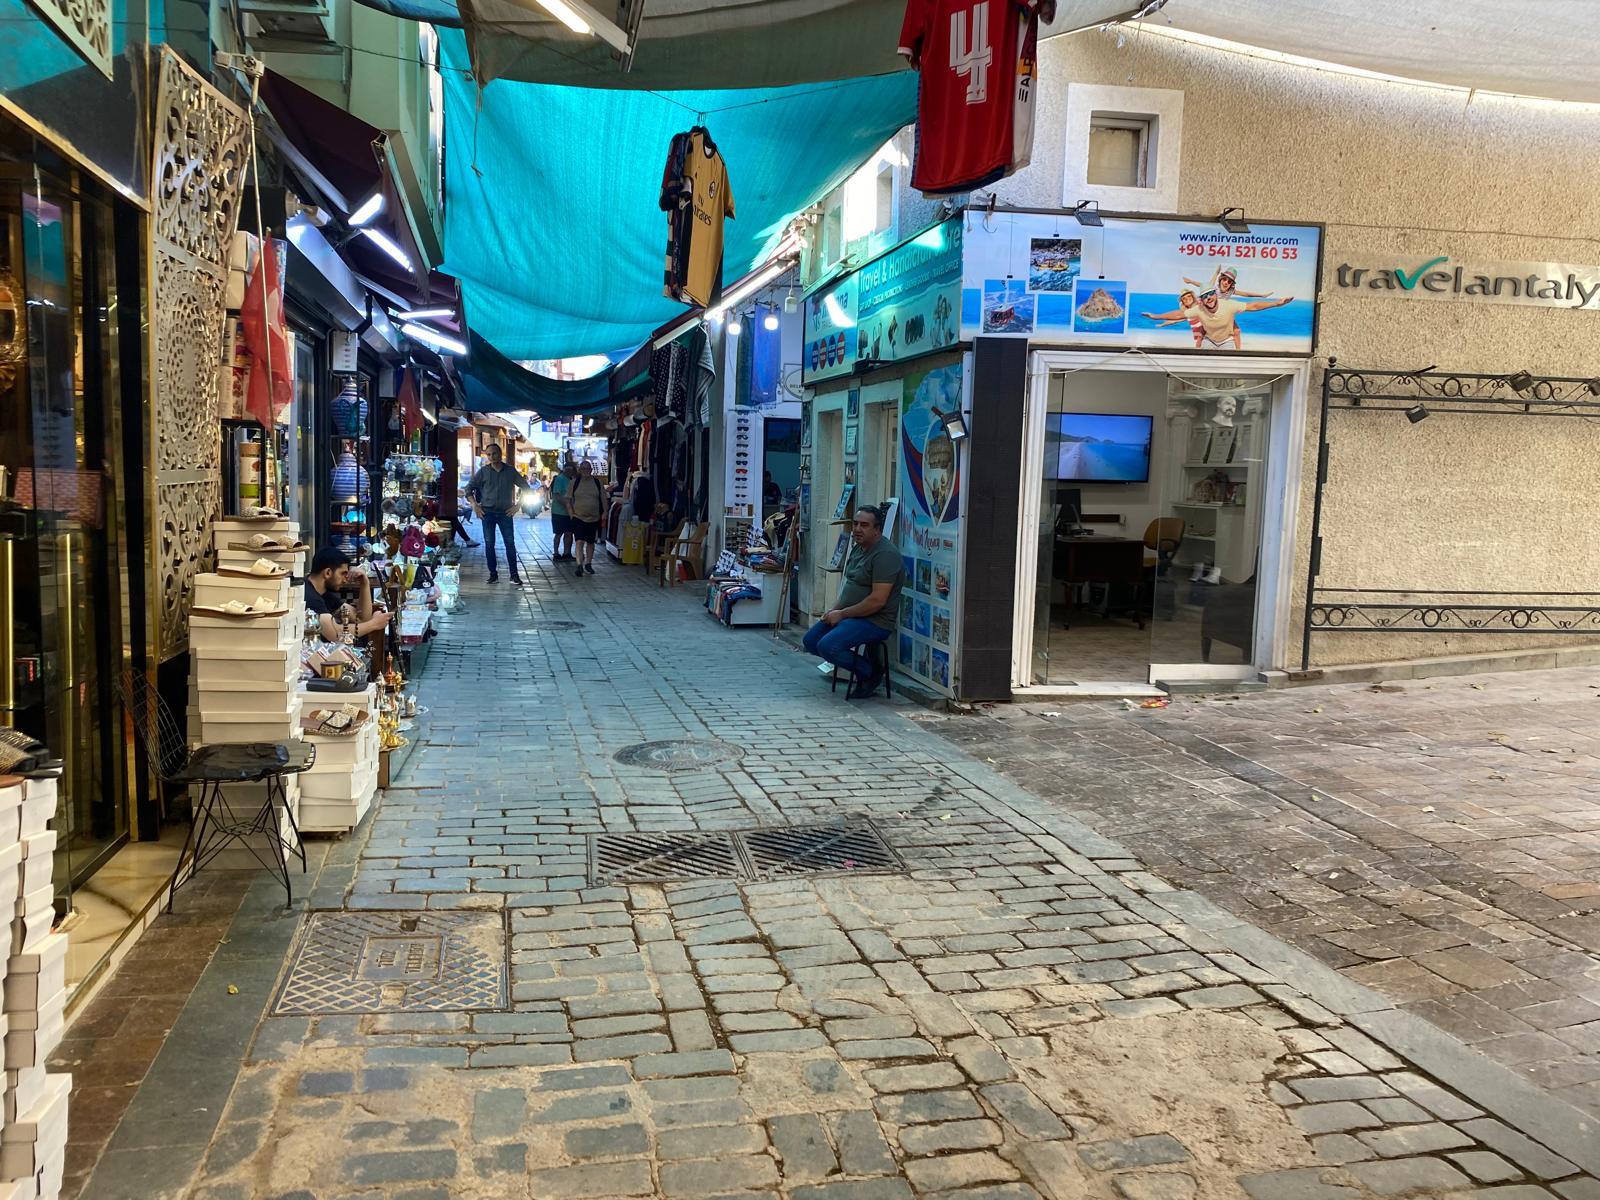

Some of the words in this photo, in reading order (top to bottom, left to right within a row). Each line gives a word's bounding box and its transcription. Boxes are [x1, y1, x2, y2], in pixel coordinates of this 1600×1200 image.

[949, 1, 992, 106] 4
[1178, 243, 1204, 256] +90
[1208, 245, 1230, 257] 541
[1235, 246, 1256, 258] 521
[1260, 247, 1278, 259] 60
[1282, 247, 1298, 260] 53
[1179, 232, 1299, 246] www.nirvanatour.com
[860, 261, 880, 293] Travel
[882, 258, 888, 284] &
